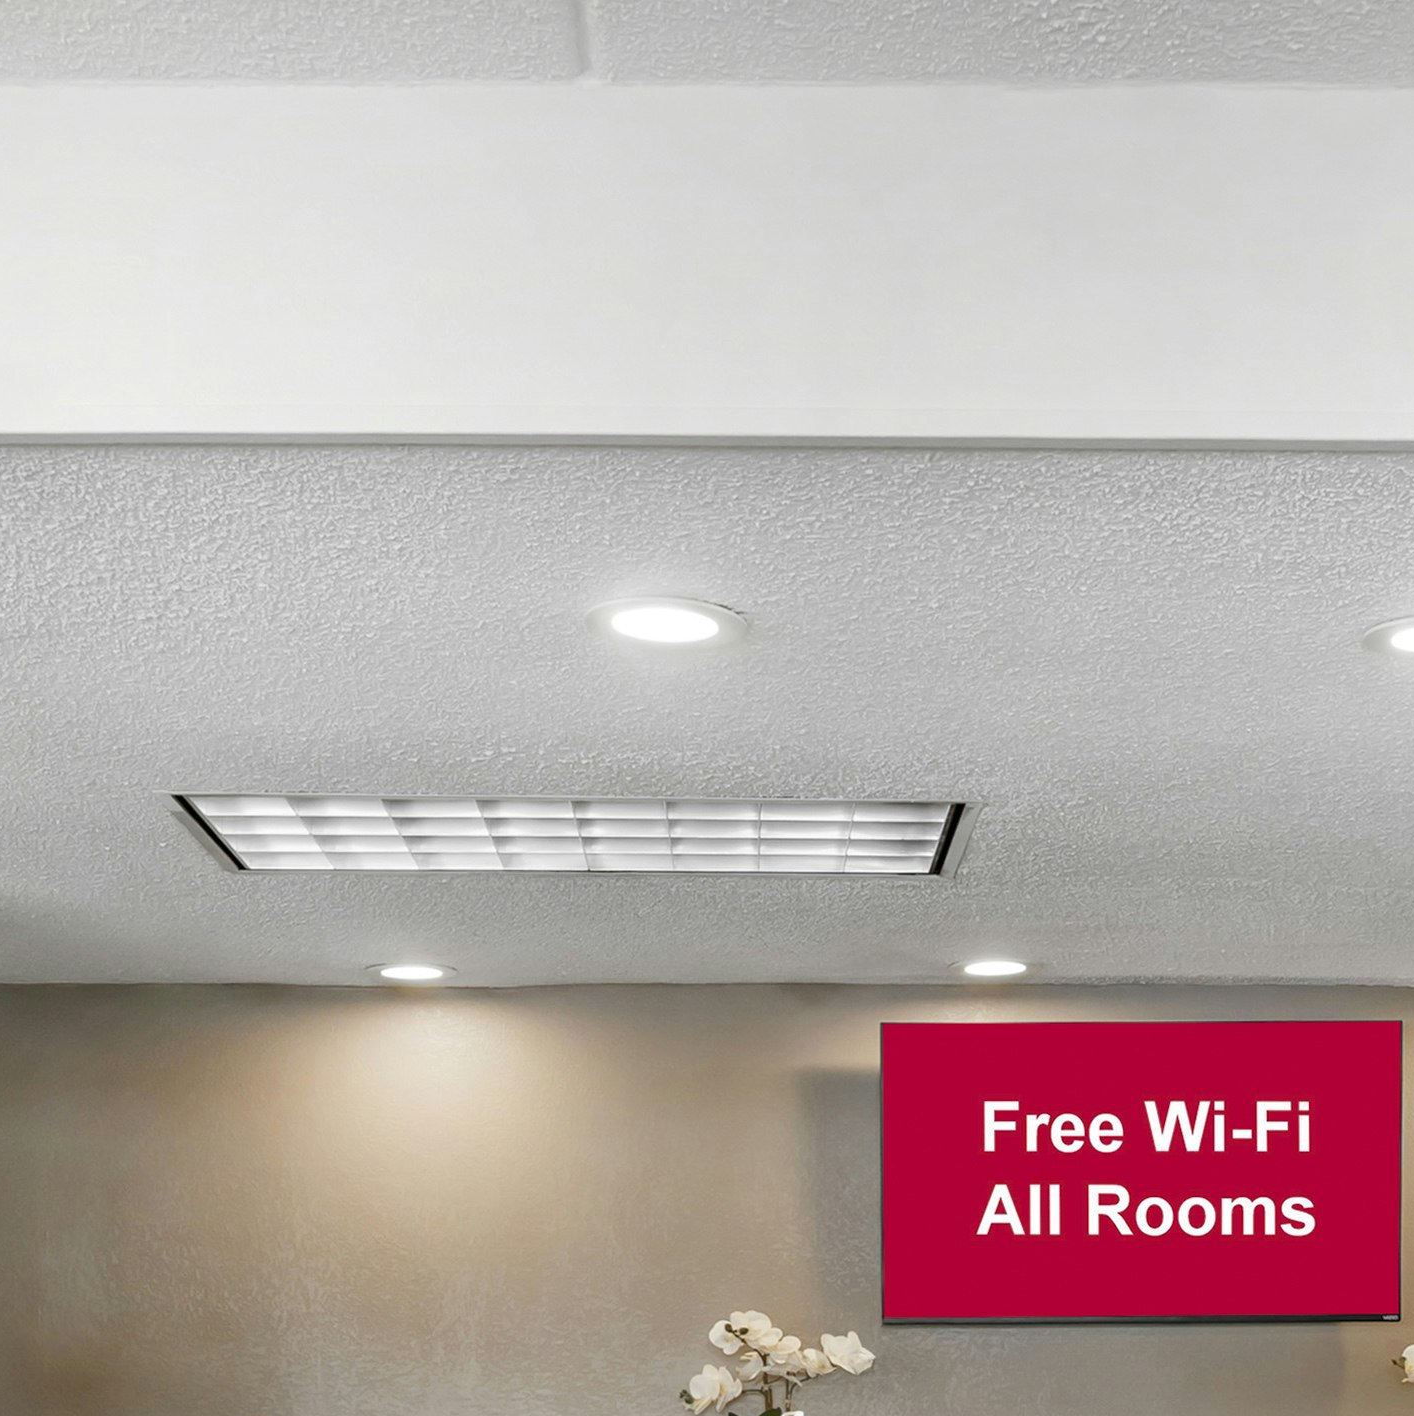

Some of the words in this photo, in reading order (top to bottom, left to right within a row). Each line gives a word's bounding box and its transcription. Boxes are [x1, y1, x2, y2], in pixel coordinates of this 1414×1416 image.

[983, 1101, 1124, 1153] Free
[1143, 1101, 1310, 1152] Wi-Fi
[976, 1184, 1061, 1236] All
[1087, 1184, 1316, 1237] Rooms
